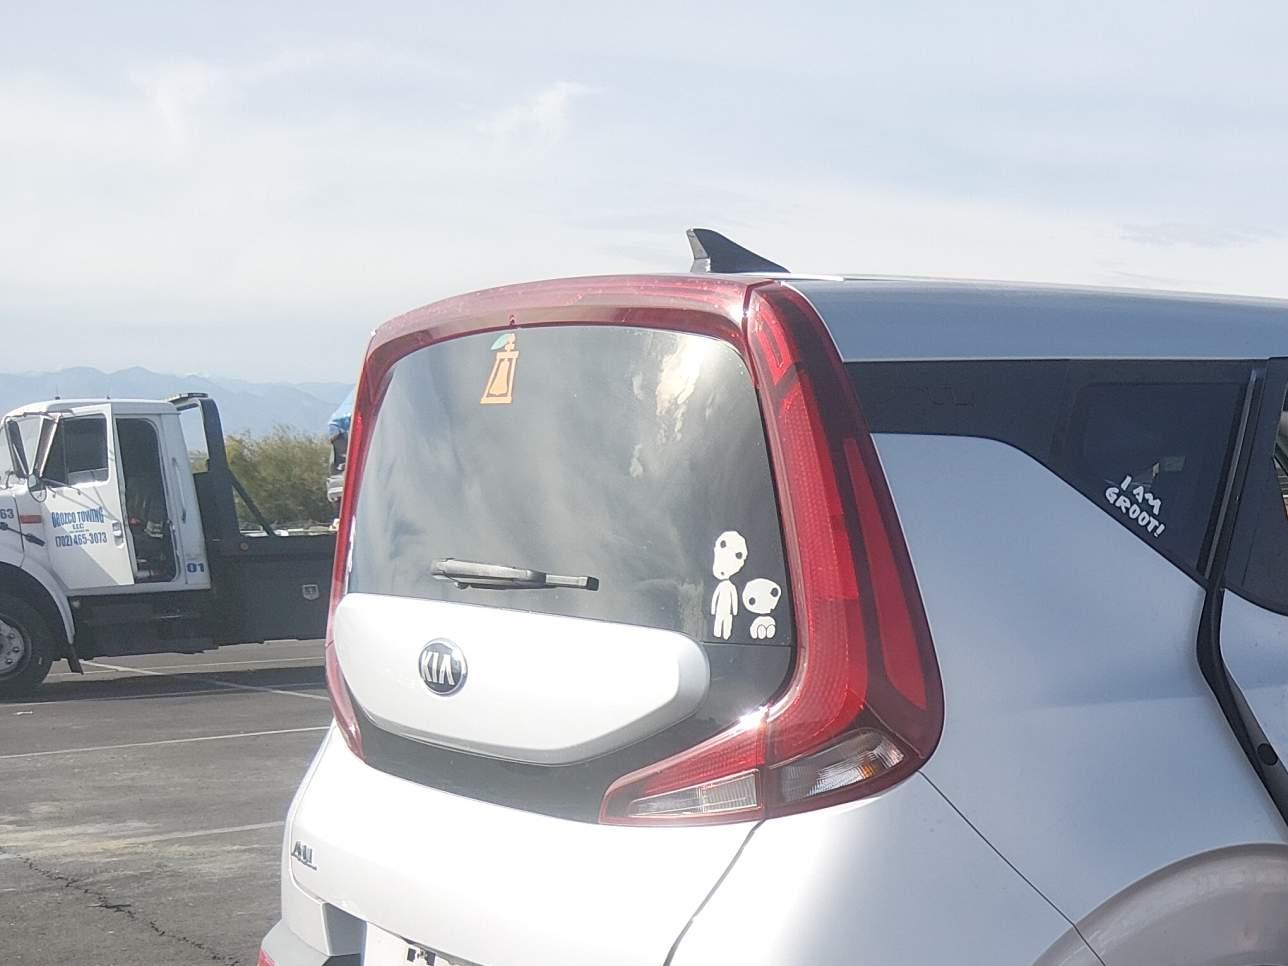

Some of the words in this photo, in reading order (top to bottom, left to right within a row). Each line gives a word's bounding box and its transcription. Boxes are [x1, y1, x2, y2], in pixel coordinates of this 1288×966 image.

[1105, 487, 1165, 537] GROOT!
[1121, 475, 1132, 491] I
[1132, 486, 1161, 515] AM
[51, 511, 76, 528] OROZCO
[76, 506, 104, 523] TOWING
[186, 562, 205, 573] 01
[421, 650, 456, 685] KIA
